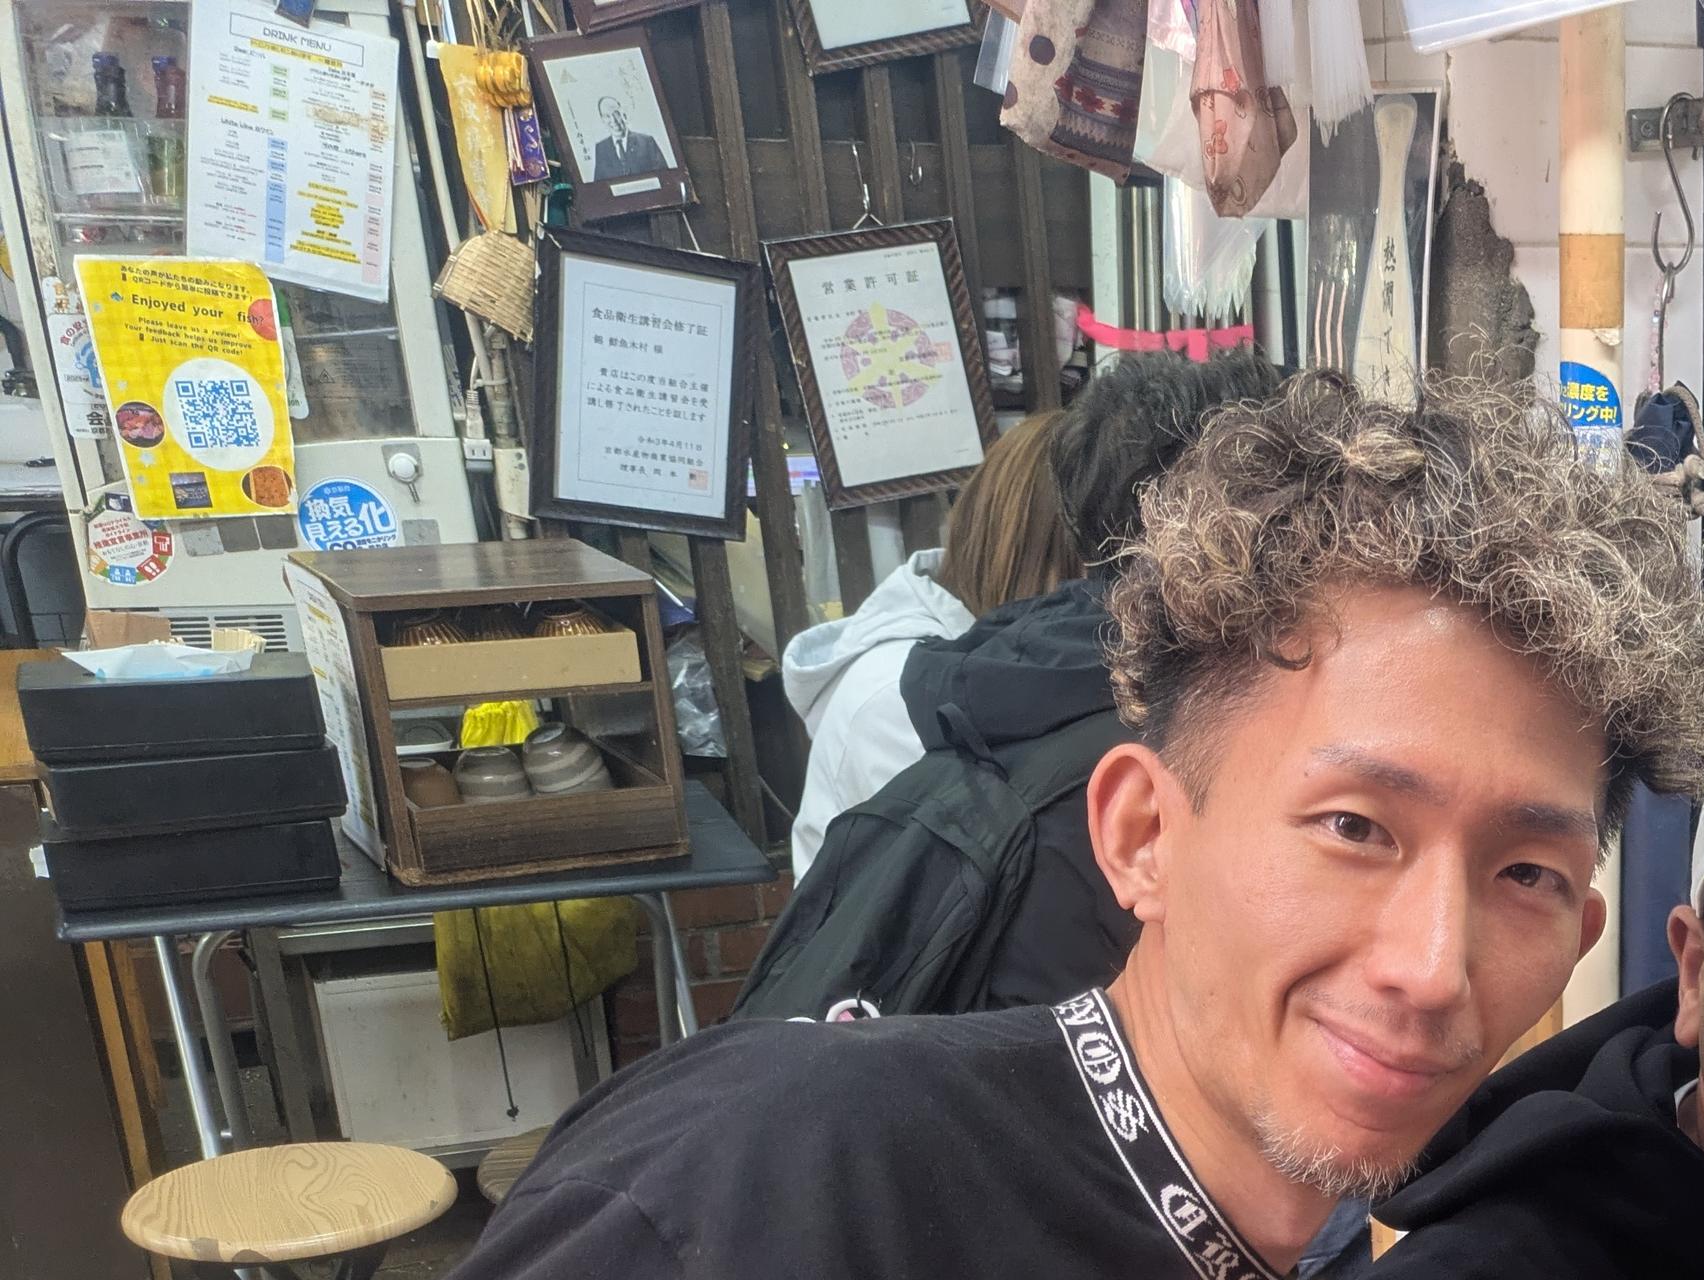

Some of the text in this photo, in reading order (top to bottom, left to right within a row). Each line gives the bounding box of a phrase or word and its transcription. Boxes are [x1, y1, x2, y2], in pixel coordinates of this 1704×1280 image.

[263, 28, 332, 51] DRINK MENU
[822, 270, 920, 295] 営業許可証
[132, 294, 264, 325] Enjoyed your fish?
[124, 323, 142, 332] Your
[145, 326, 180, 338] feedback
[184, 332, 205, 343] helps
[139, 317, 163, 326] Please
[167, 321, 187, 331] leave
[212, 329, 240, 339] review!
[151, 336, 243, 356] Just scan the QR code!
